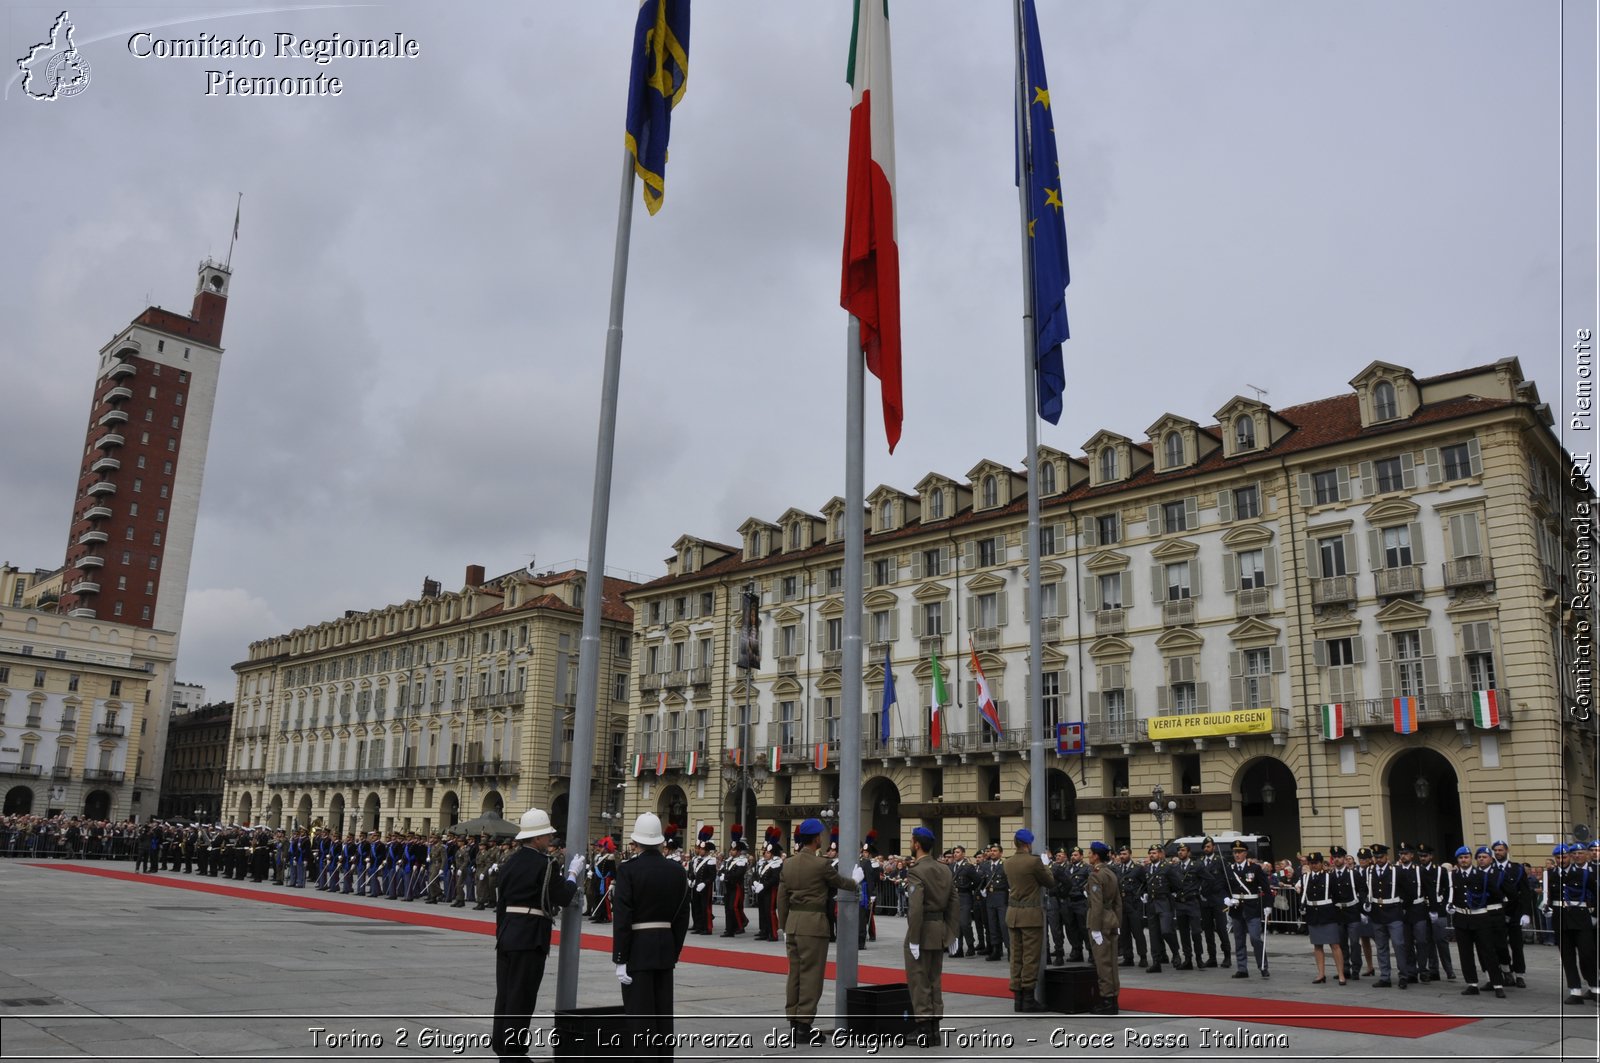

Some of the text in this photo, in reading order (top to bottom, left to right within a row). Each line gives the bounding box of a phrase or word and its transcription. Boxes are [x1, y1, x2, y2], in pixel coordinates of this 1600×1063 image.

[1153, 712, 1266, 729] VERITÀ PER GIULIO REGENI
